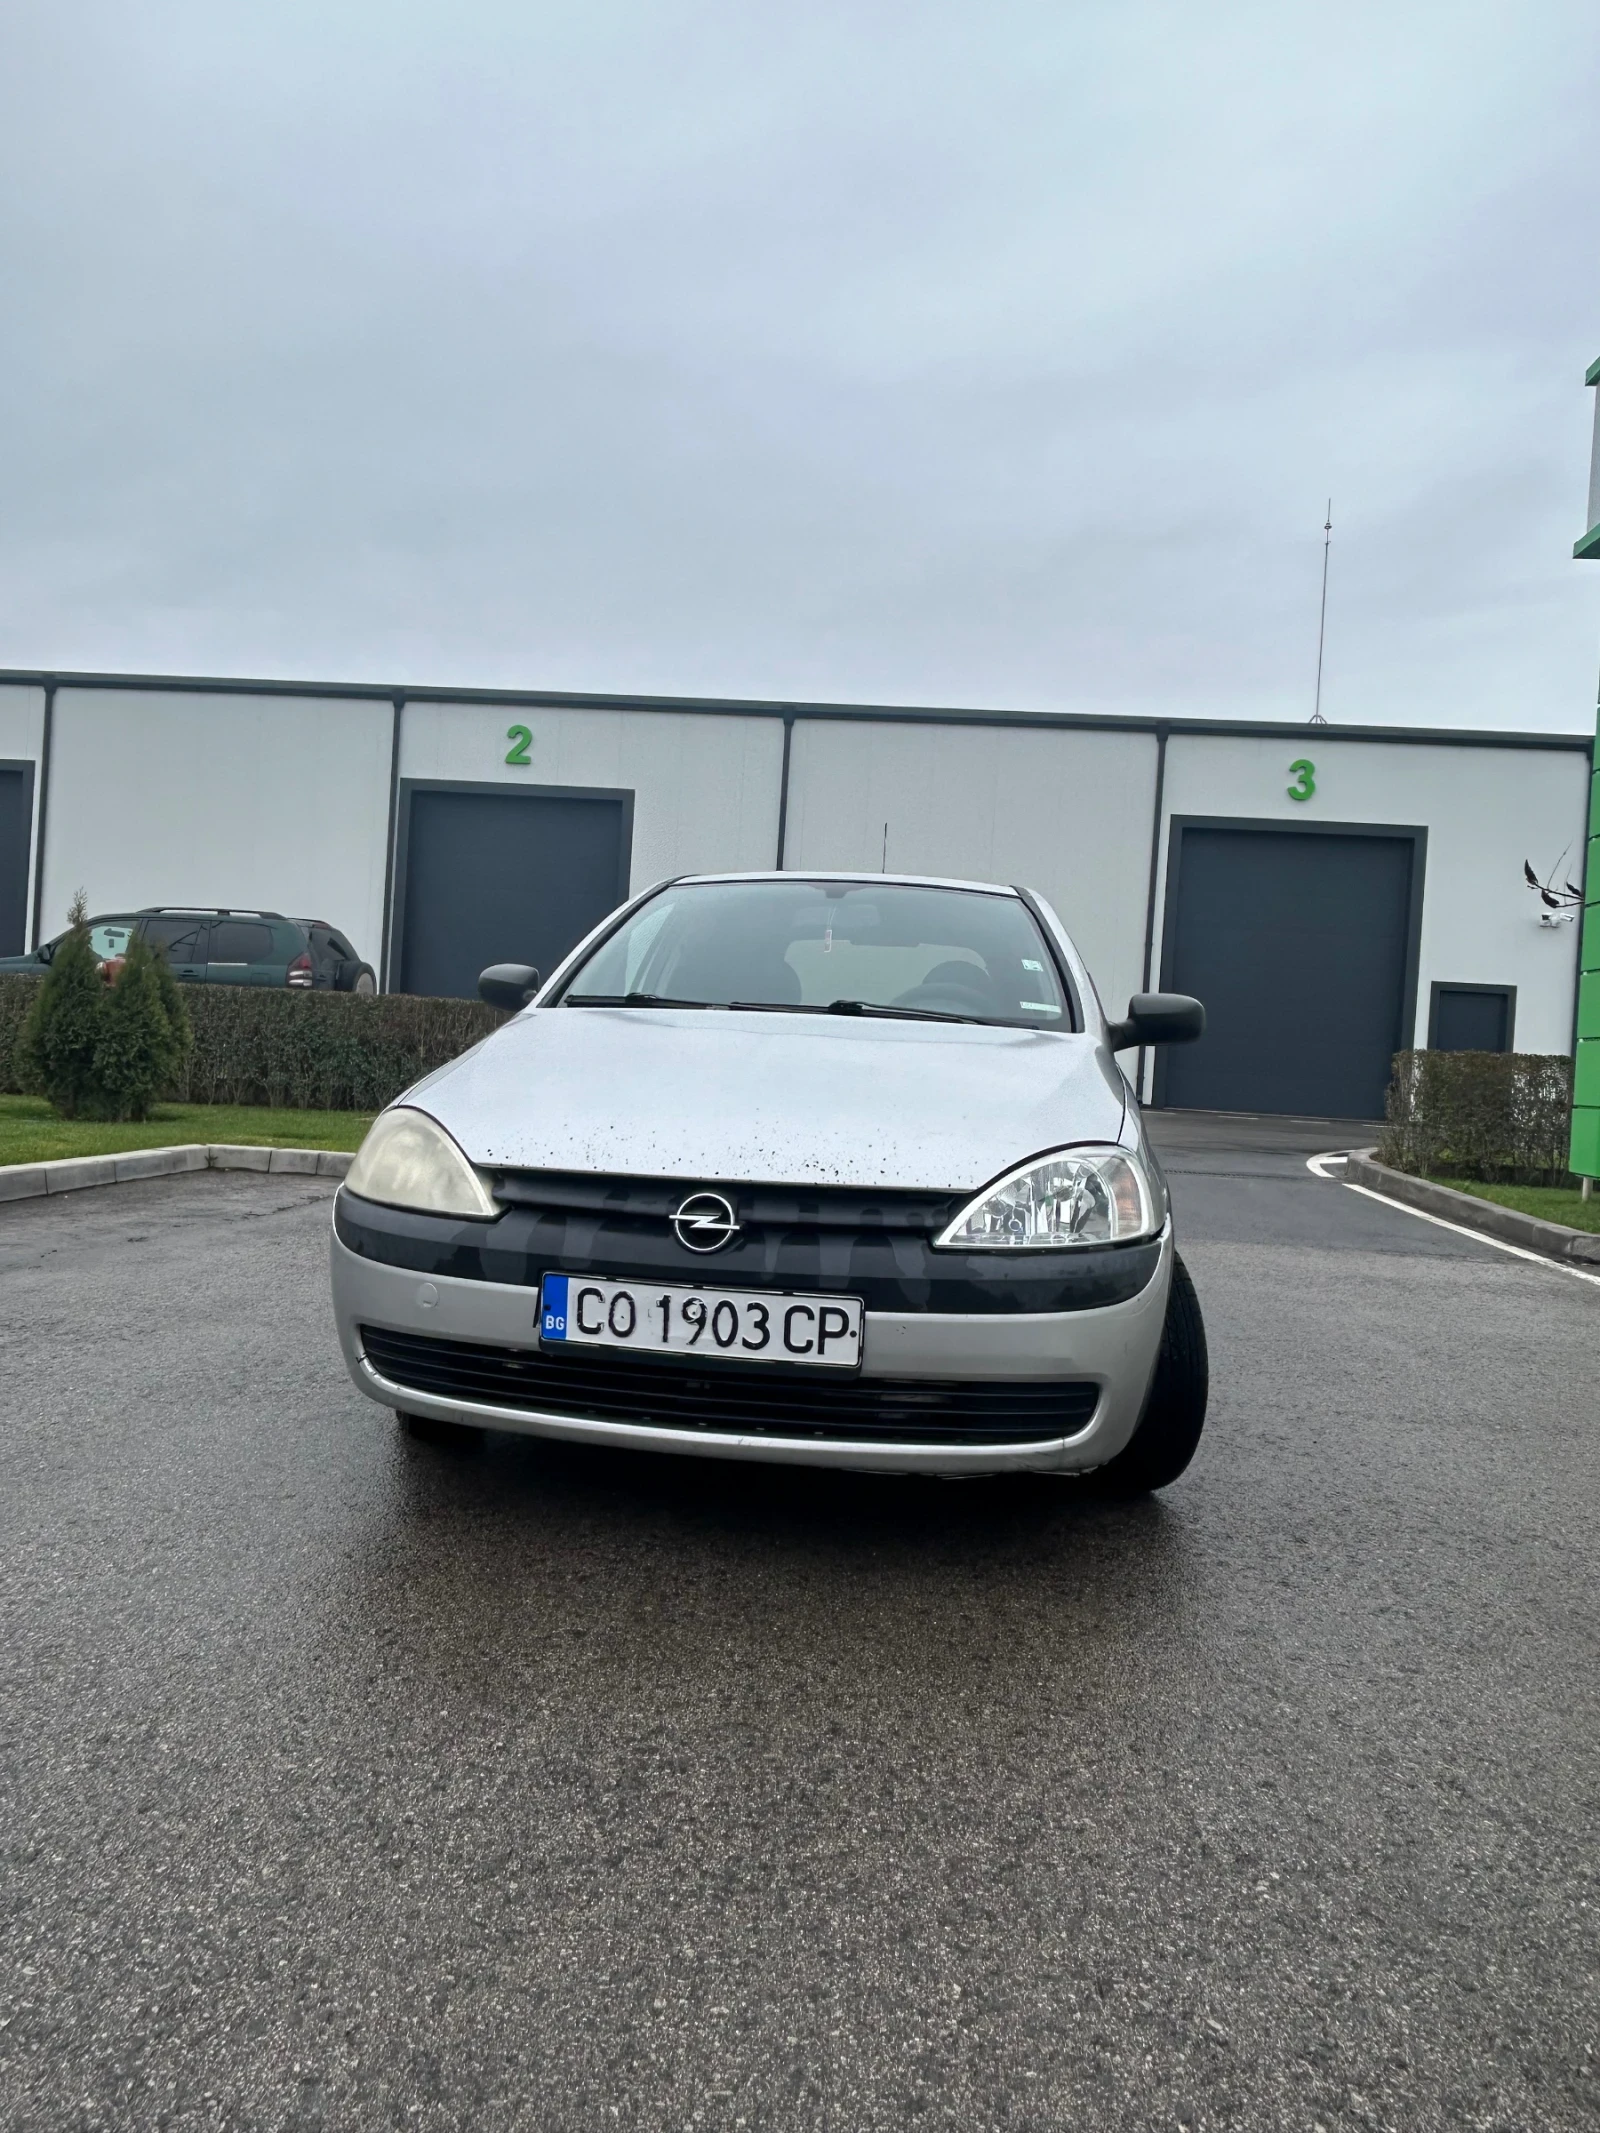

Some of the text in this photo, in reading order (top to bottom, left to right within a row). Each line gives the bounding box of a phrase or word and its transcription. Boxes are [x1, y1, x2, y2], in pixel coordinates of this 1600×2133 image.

[505, 725, 533, 765] 2
[1287, 759, 1316, 801] 3
[545, 1314, 565, 1331] BG
[655, 1294, 771, 1350] 1903
[783, 1304, 850, 1355] CP
